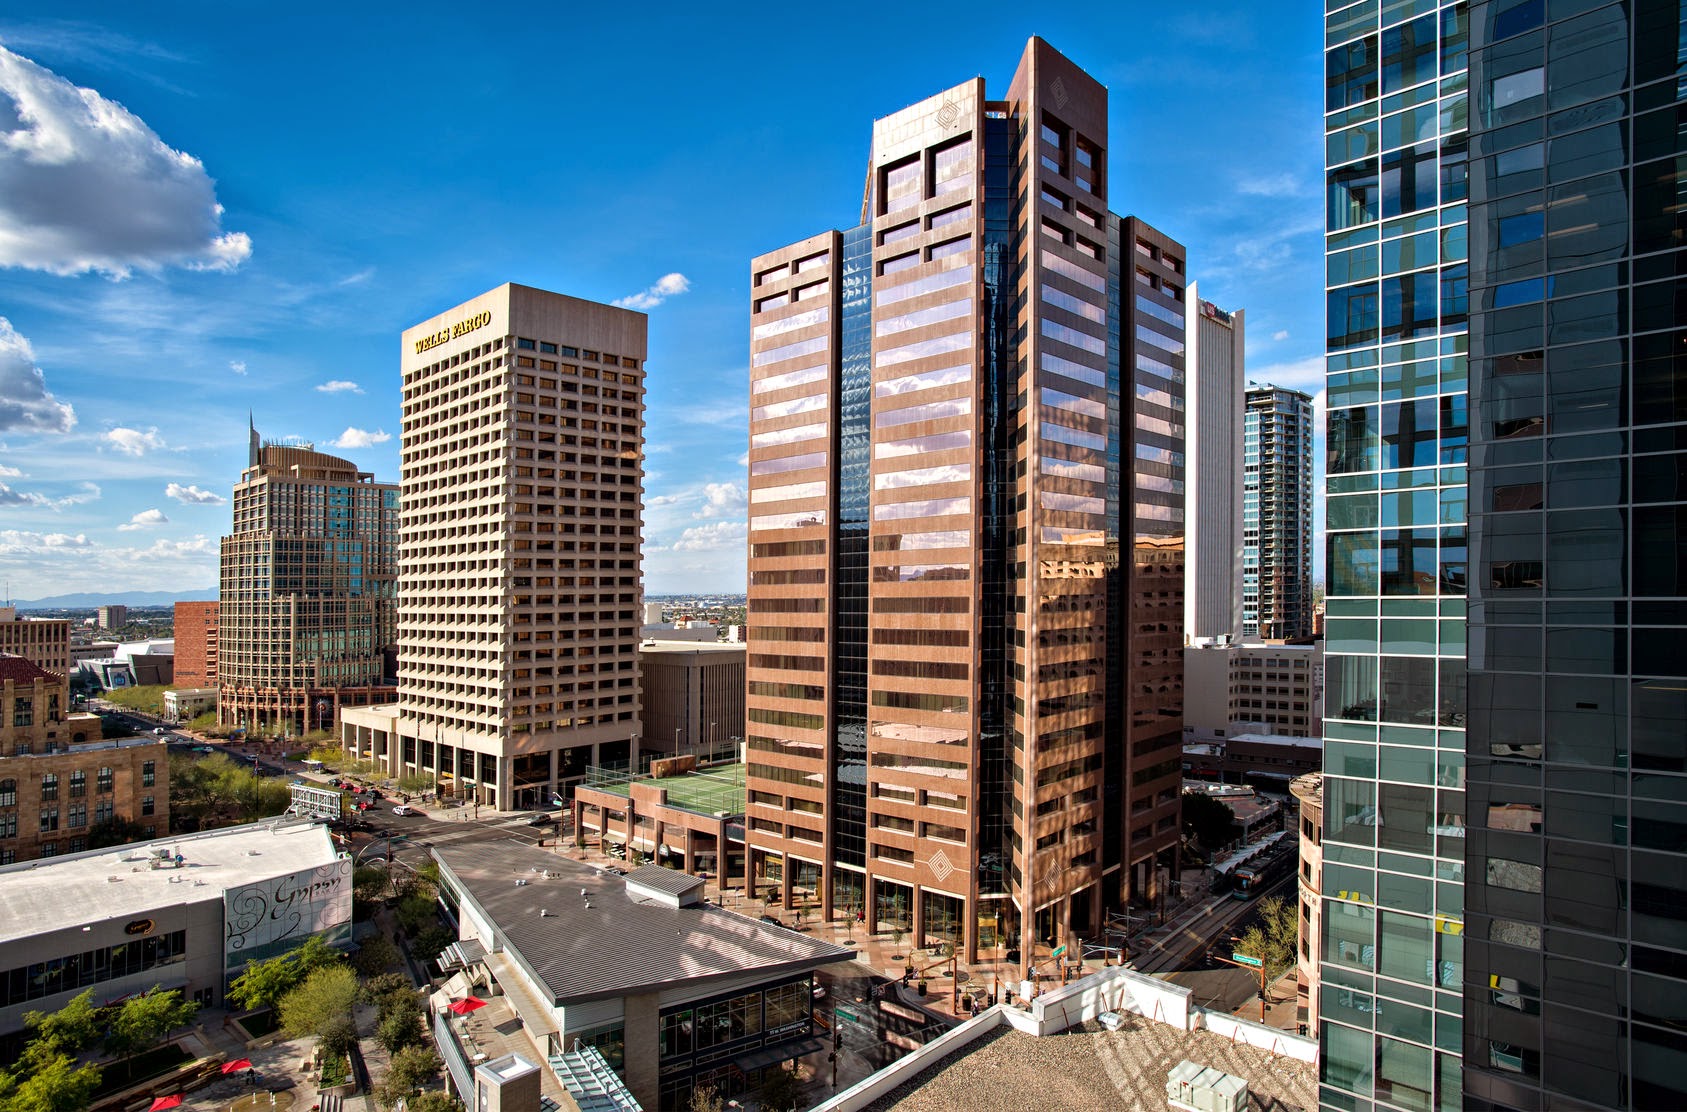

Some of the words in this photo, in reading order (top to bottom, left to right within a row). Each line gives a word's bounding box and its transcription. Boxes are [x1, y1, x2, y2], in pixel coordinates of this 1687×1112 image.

[414, 327, 450, 355] WELLS
[451, 309, 491, 340] FARGO
[271, 875, 341, 920] Gypsy
